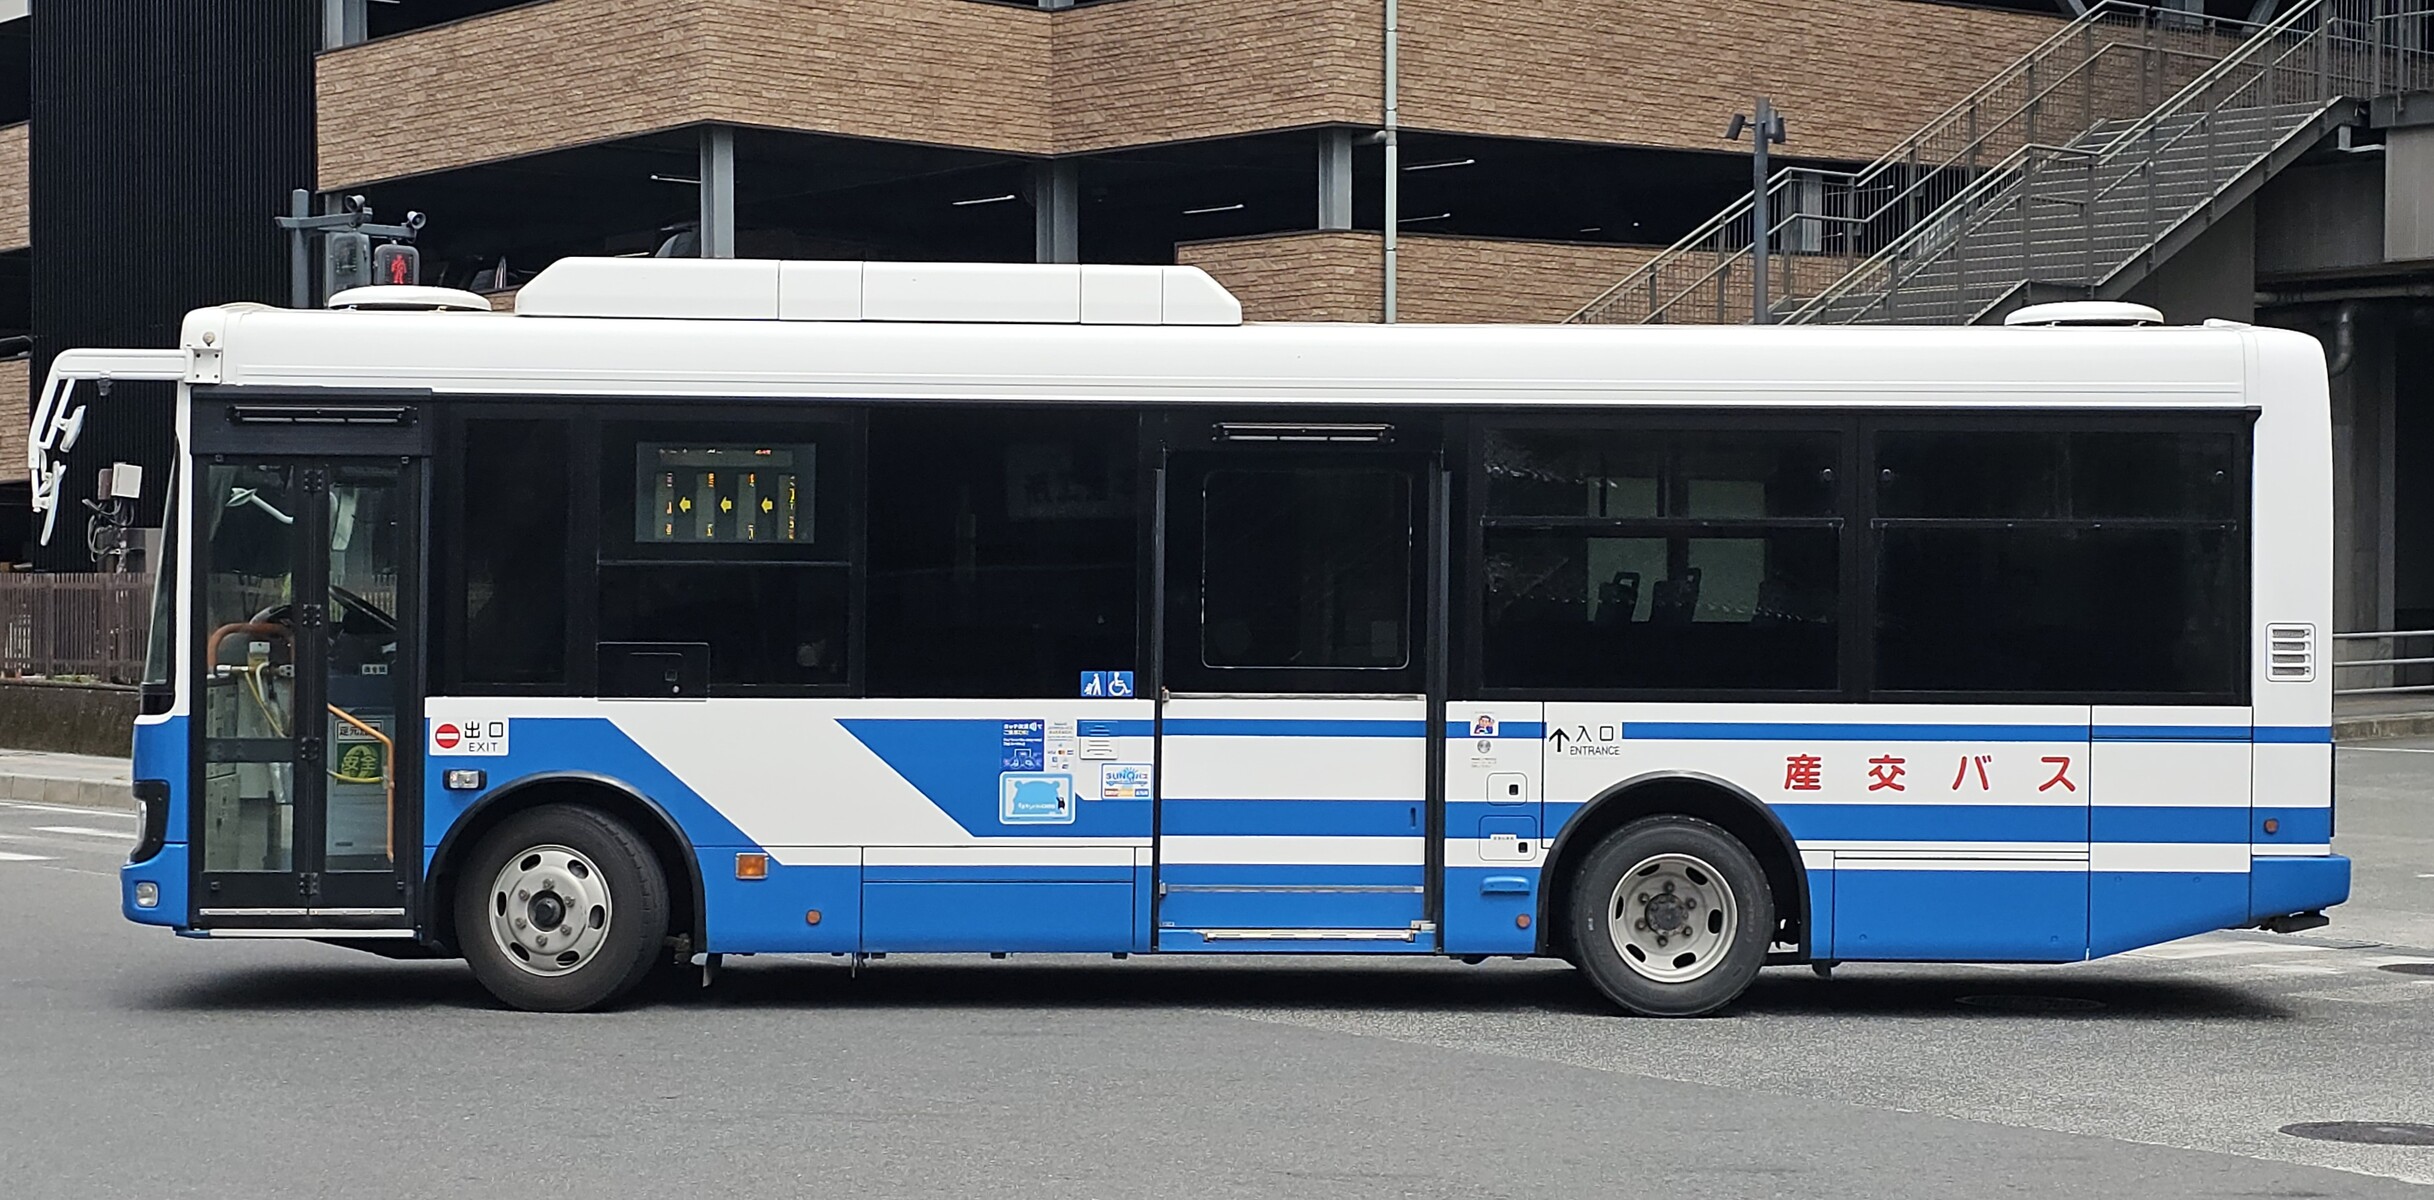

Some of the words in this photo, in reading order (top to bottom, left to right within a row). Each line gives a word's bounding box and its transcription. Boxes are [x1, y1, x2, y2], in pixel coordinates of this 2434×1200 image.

[464, 720, 504, 739] 出口
[1575, 725, 1614, 742] 入口
[468, 742, 498, 752] EXIT
[1569, 746, 1620, 756] ENTRANCE
[1784, 754, 2077, 792] 産交バス
